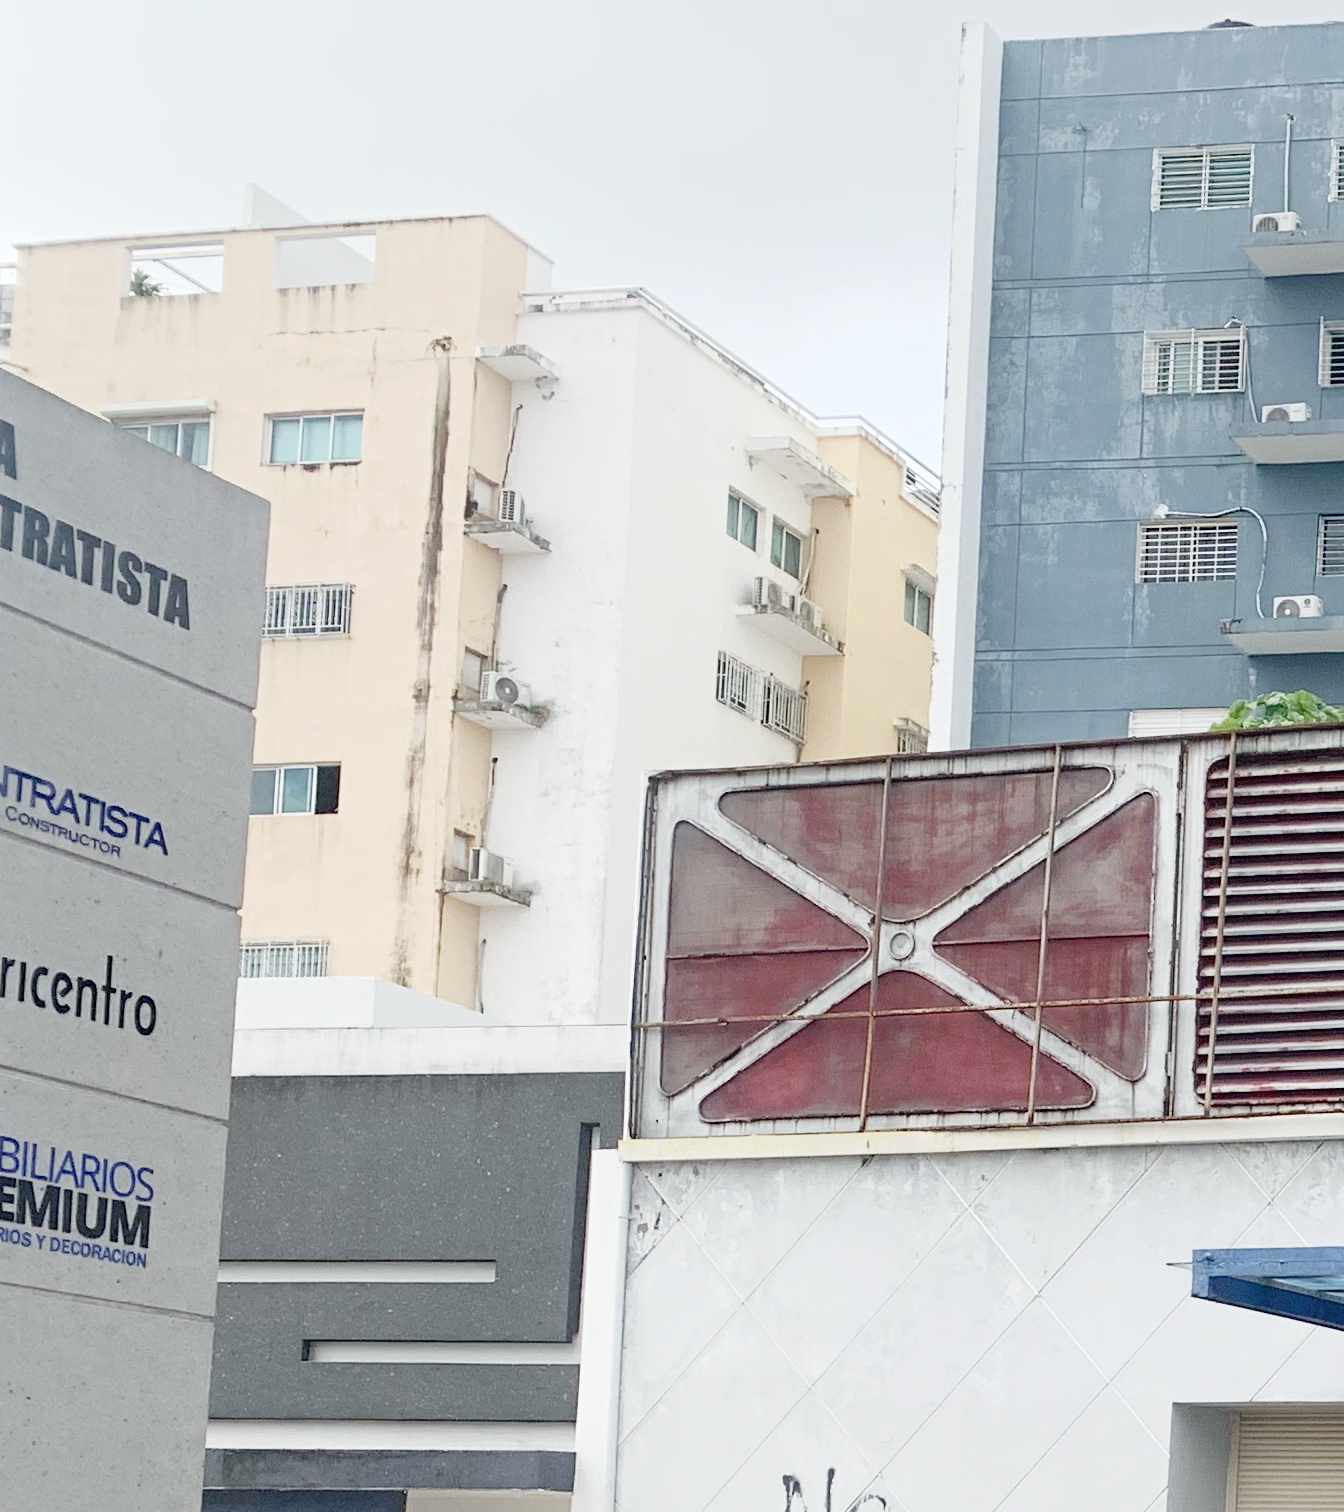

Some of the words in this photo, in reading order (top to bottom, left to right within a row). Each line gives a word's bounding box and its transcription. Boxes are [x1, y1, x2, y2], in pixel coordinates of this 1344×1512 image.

[0, 493, 191, 631] TRATISTA
[0, 954, 157, 1036] ricentro
[0, 1135, 154, 1203] BILIARIOS
[36, 1233, 46, 1250] Y
[50, 1237, 148, 1268] DECORACION
